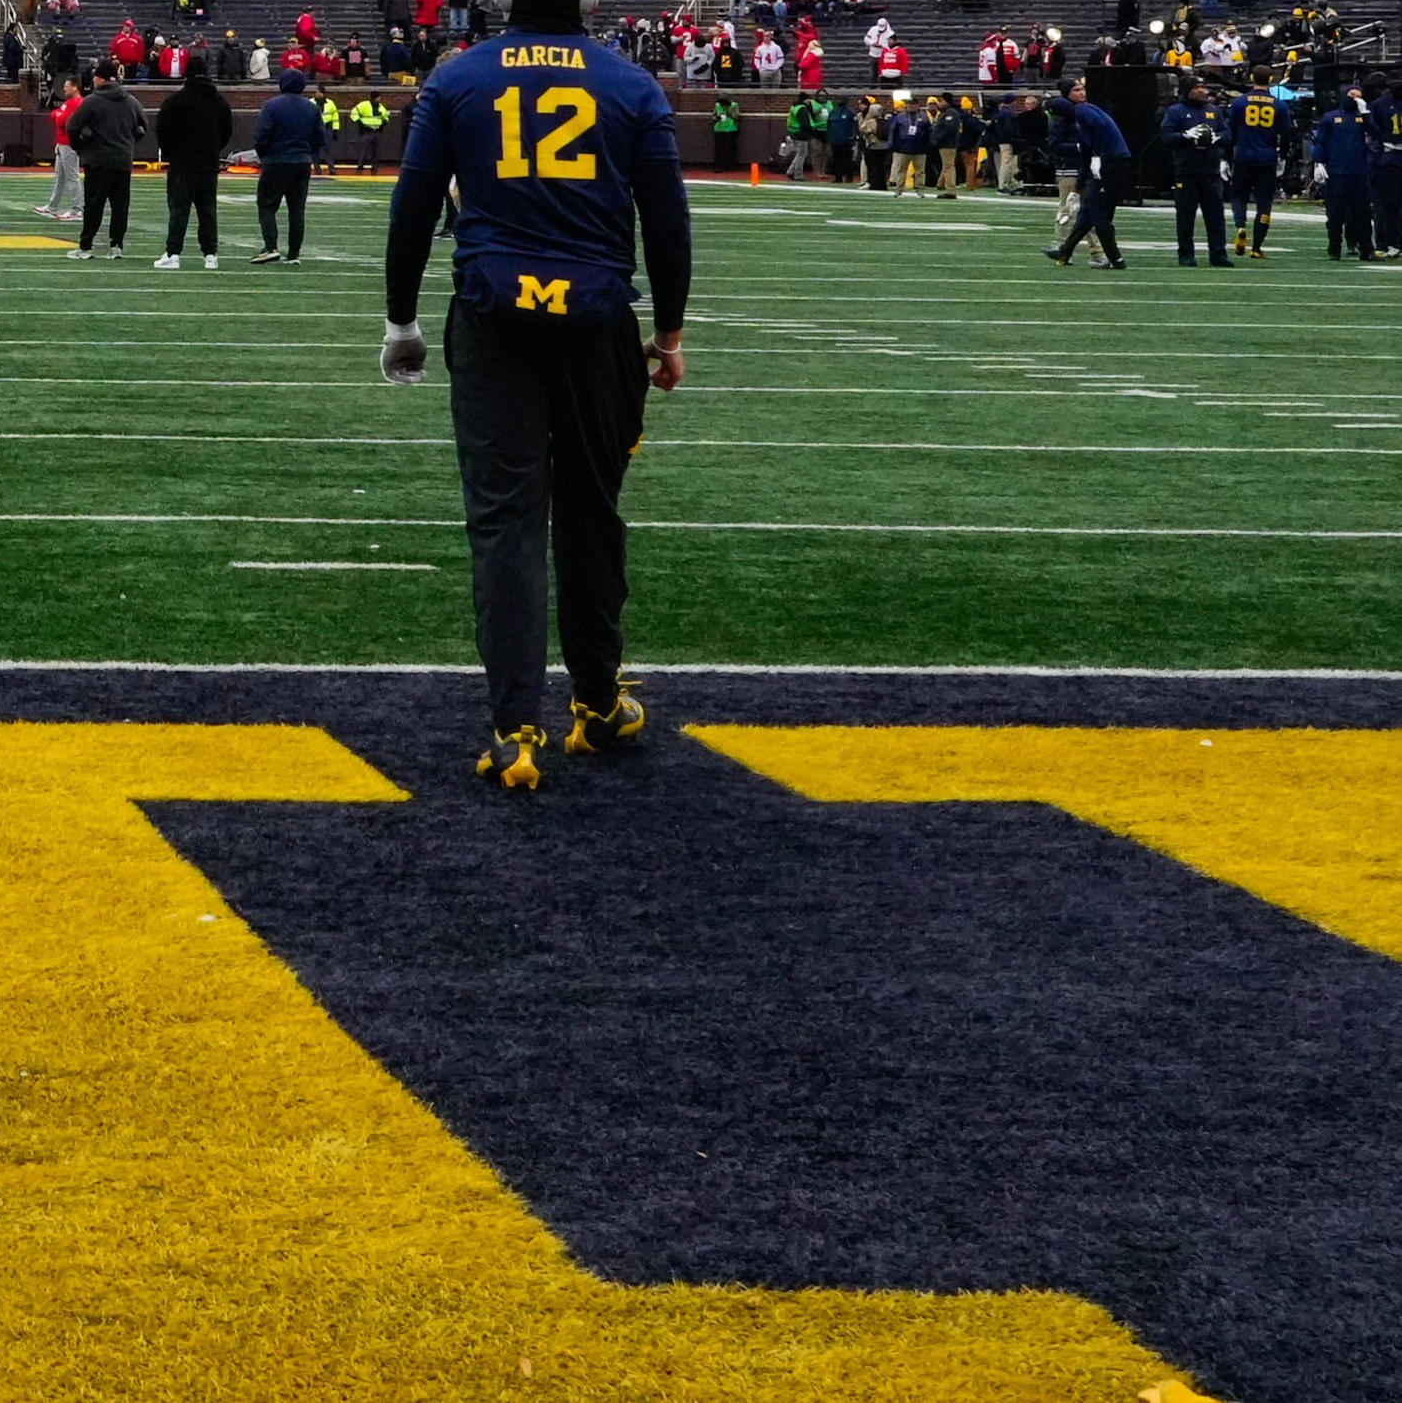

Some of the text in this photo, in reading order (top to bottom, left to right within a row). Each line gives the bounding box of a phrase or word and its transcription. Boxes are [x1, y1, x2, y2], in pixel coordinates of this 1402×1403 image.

[501, 45, 586, 70] GARCIA
[1245, 104, 1275, 128] 89
[1391, 112, 1402, 135] 1
[494, 85, 598, 180] 12
[515, 274, 571, 316] M
